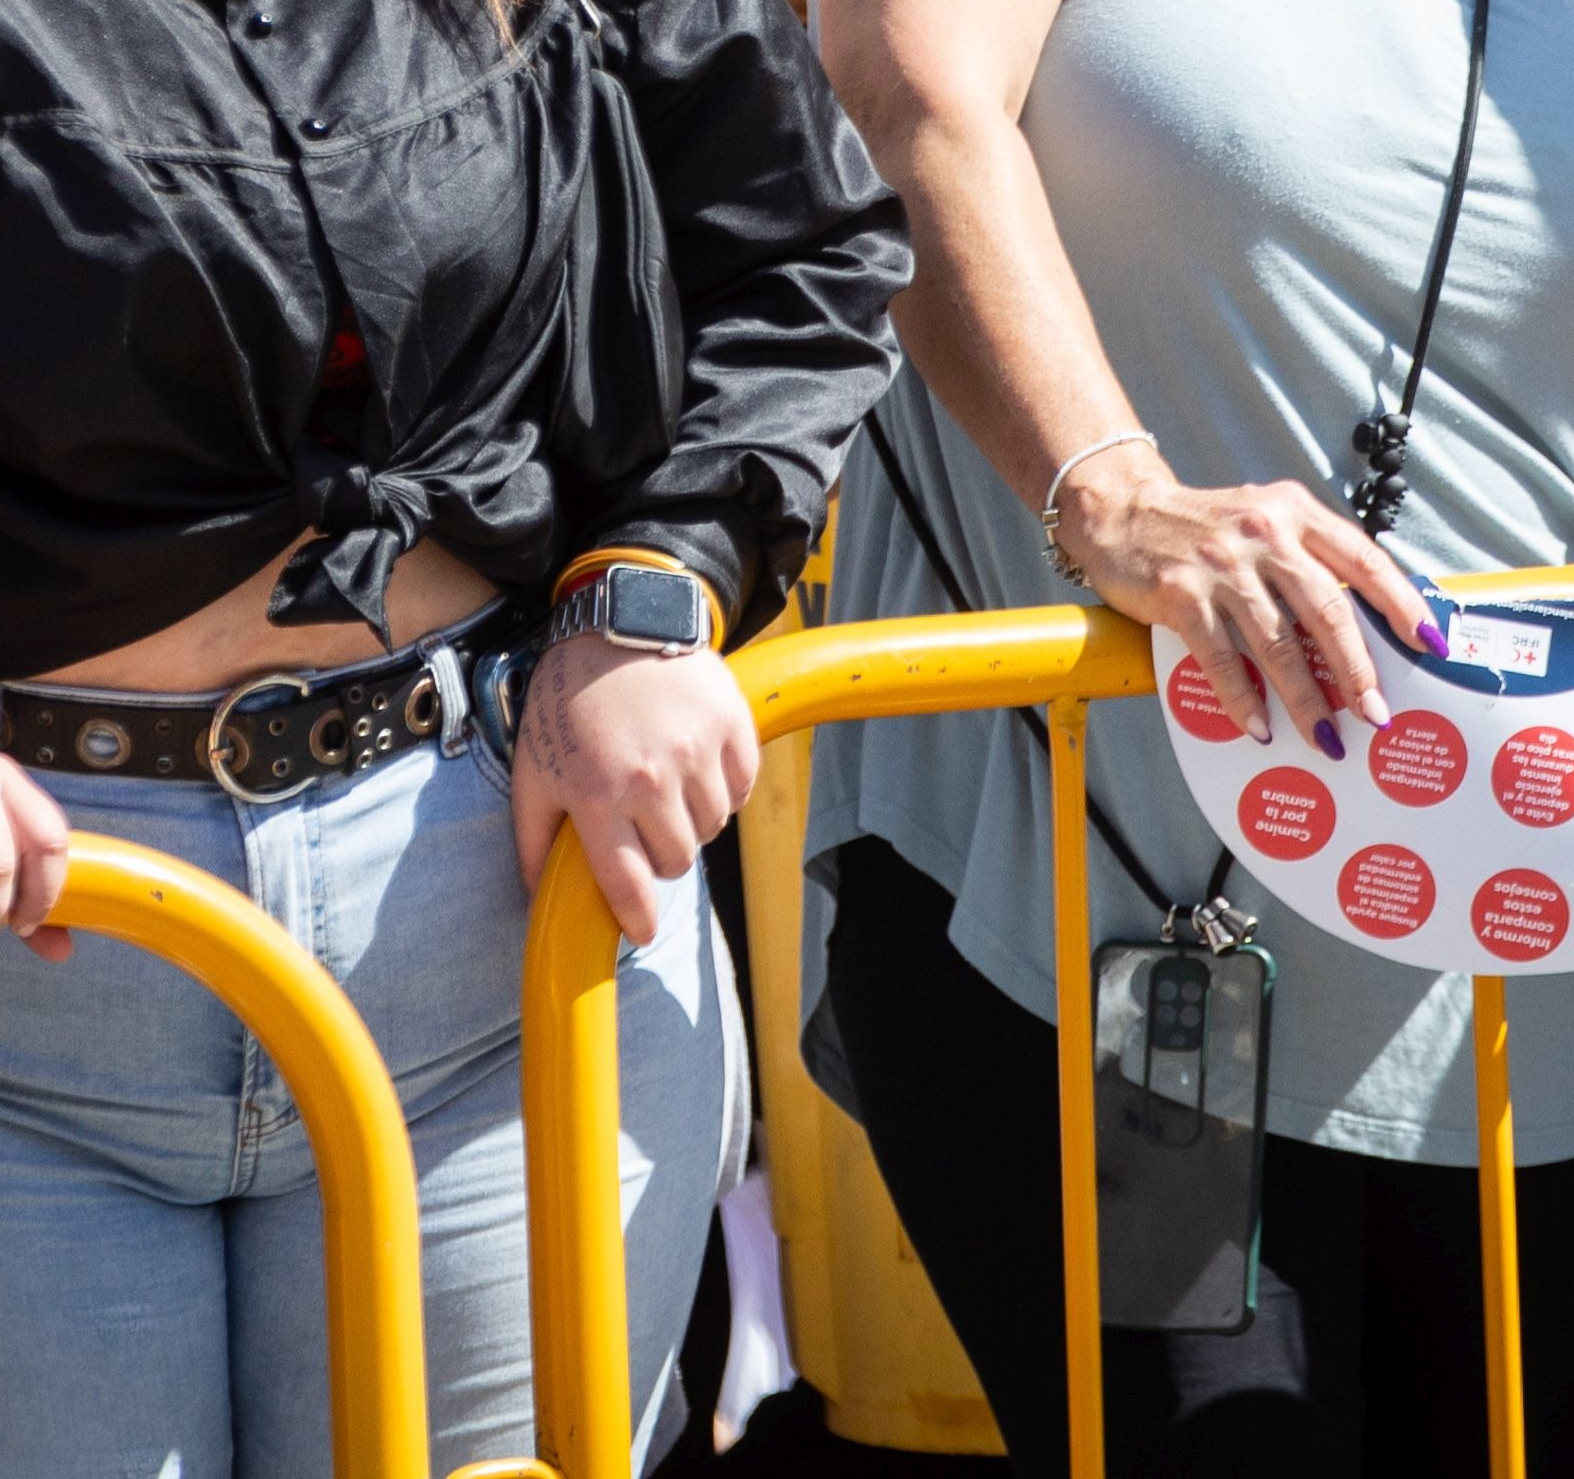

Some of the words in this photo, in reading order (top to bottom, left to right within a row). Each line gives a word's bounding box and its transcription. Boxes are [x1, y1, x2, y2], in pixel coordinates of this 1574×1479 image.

[1180, 700, 1196, 711] las
[1389, 736, 1398, 746] y
[1406, 728, 1437, 741] alerta
[1399, 739, 1432, 752] avisos
[1434, 746, 1448, 756] de
[1506, 739, 1526, 752] del
[1527, 744, 1552, 757] pico
[1378, 747, 1420, 763] sistema
[1422, 756, 1433, 766] el
[1512, 754, 1529, 767] las
[1434, 758, 1455, 769] con
[1530, 758, 1574, 774] durante
[1386, 762, 1442, 781] informado
[1520, 769, 1562, 786] intenso
[1515, 781, 1562, 798] ejercicio
[1262, 790, 1316, 809] sombra
[1503, 792, 1514, 801] el
[1514, 791, 1524, 802] y
[1525, 796, 1570, 812] deporte
[1265, 806, 1279, 820] la
[1281, 810, 1307, 823] por
[1510, 806, 1525, 816] el
[1526, 808, 1555, 822] Evite
[1255, 820, 1311, 842] Camine
[1494, 881, 1557, 901] consejos
[1503, 899, 1542, 914] estos
[1485, 912, 1555, 933] comparta
[1481, 925, 1492, 937] y
[1493, 929, 1551, 950] Informe
